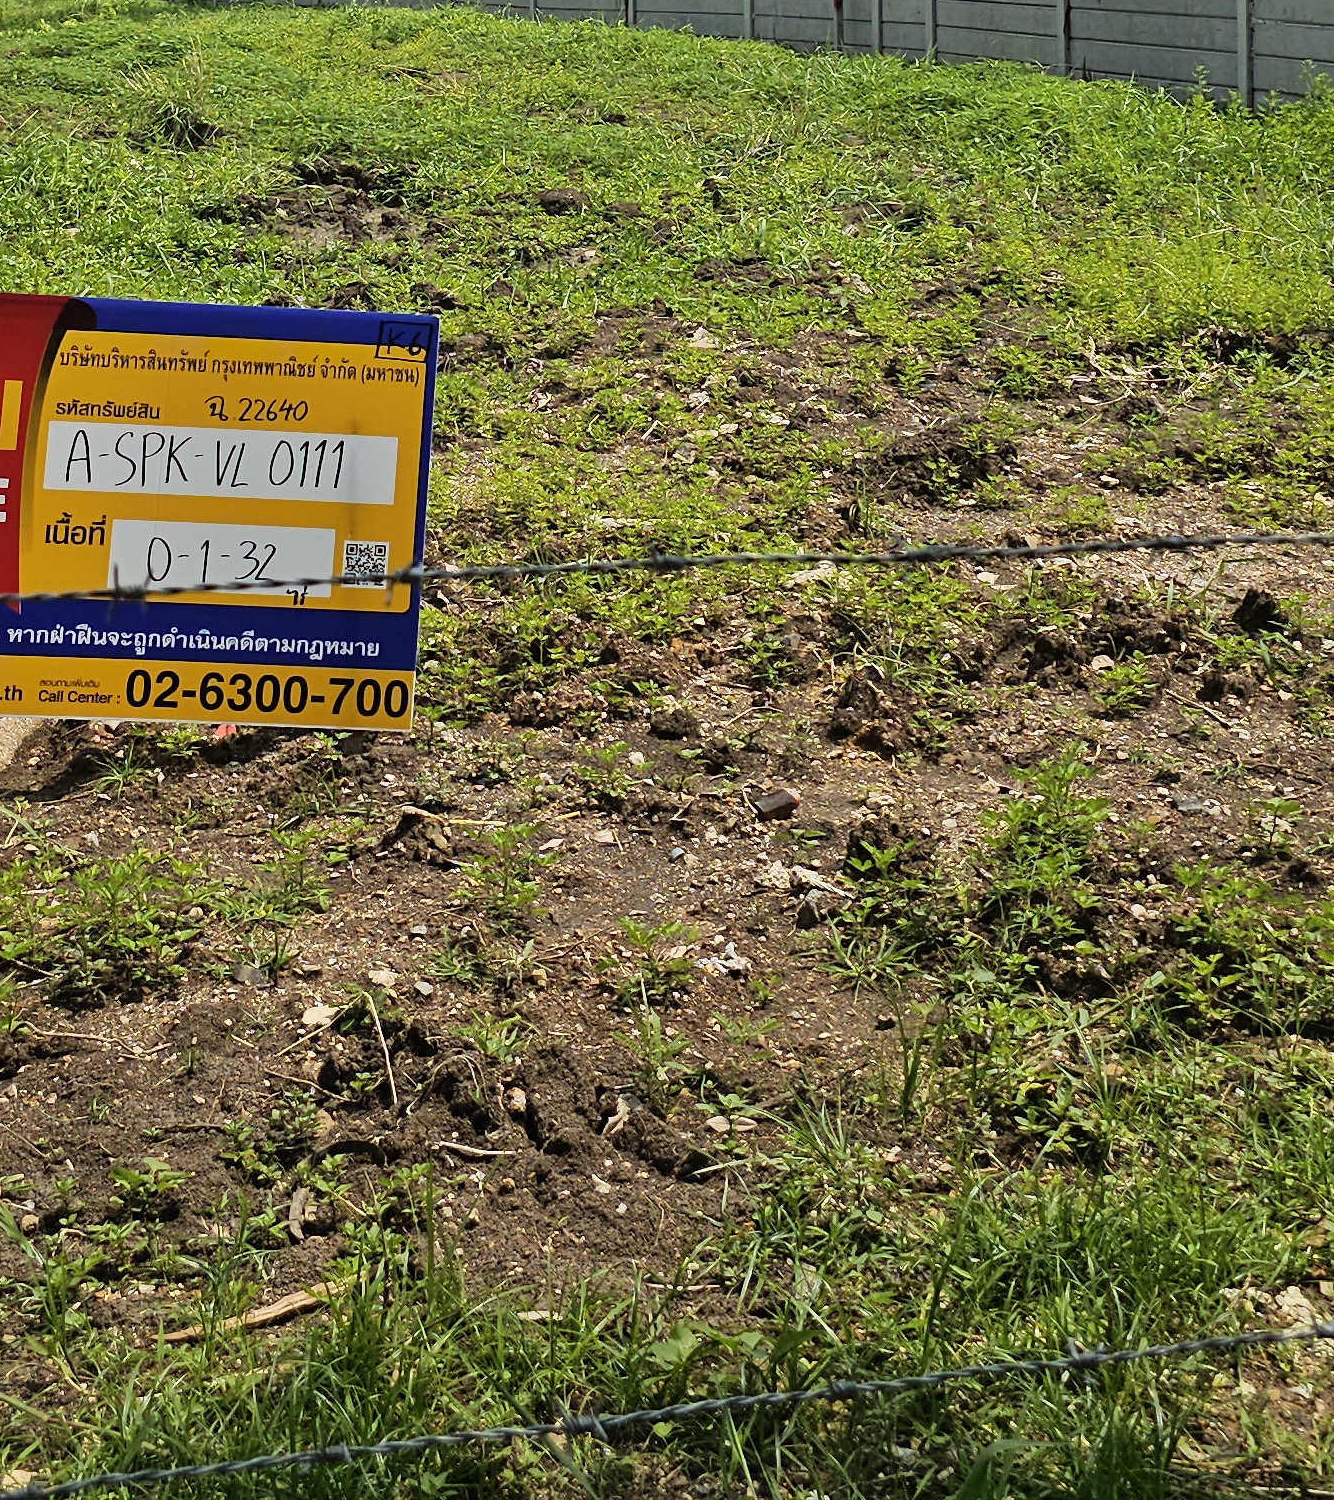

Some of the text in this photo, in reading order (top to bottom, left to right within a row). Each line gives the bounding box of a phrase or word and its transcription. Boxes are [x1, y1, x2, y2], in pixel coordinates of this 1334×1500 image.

[59, 344, 419, 388] บริษัทบริหารสินทรัพย์ กรุงเทพพาณิชย์ จำกัด (มหาชน)
[55, 399, 161, 420] รหัสทรัพย์สิน
[268, 439, 345, 489] 0111
[44, 511, 107, 546] เนื้อที่
[38, 689, 64, 703] Call
[67, 690, 113, 704] Center
[125, 668, 410, 718] 02-6300-700
